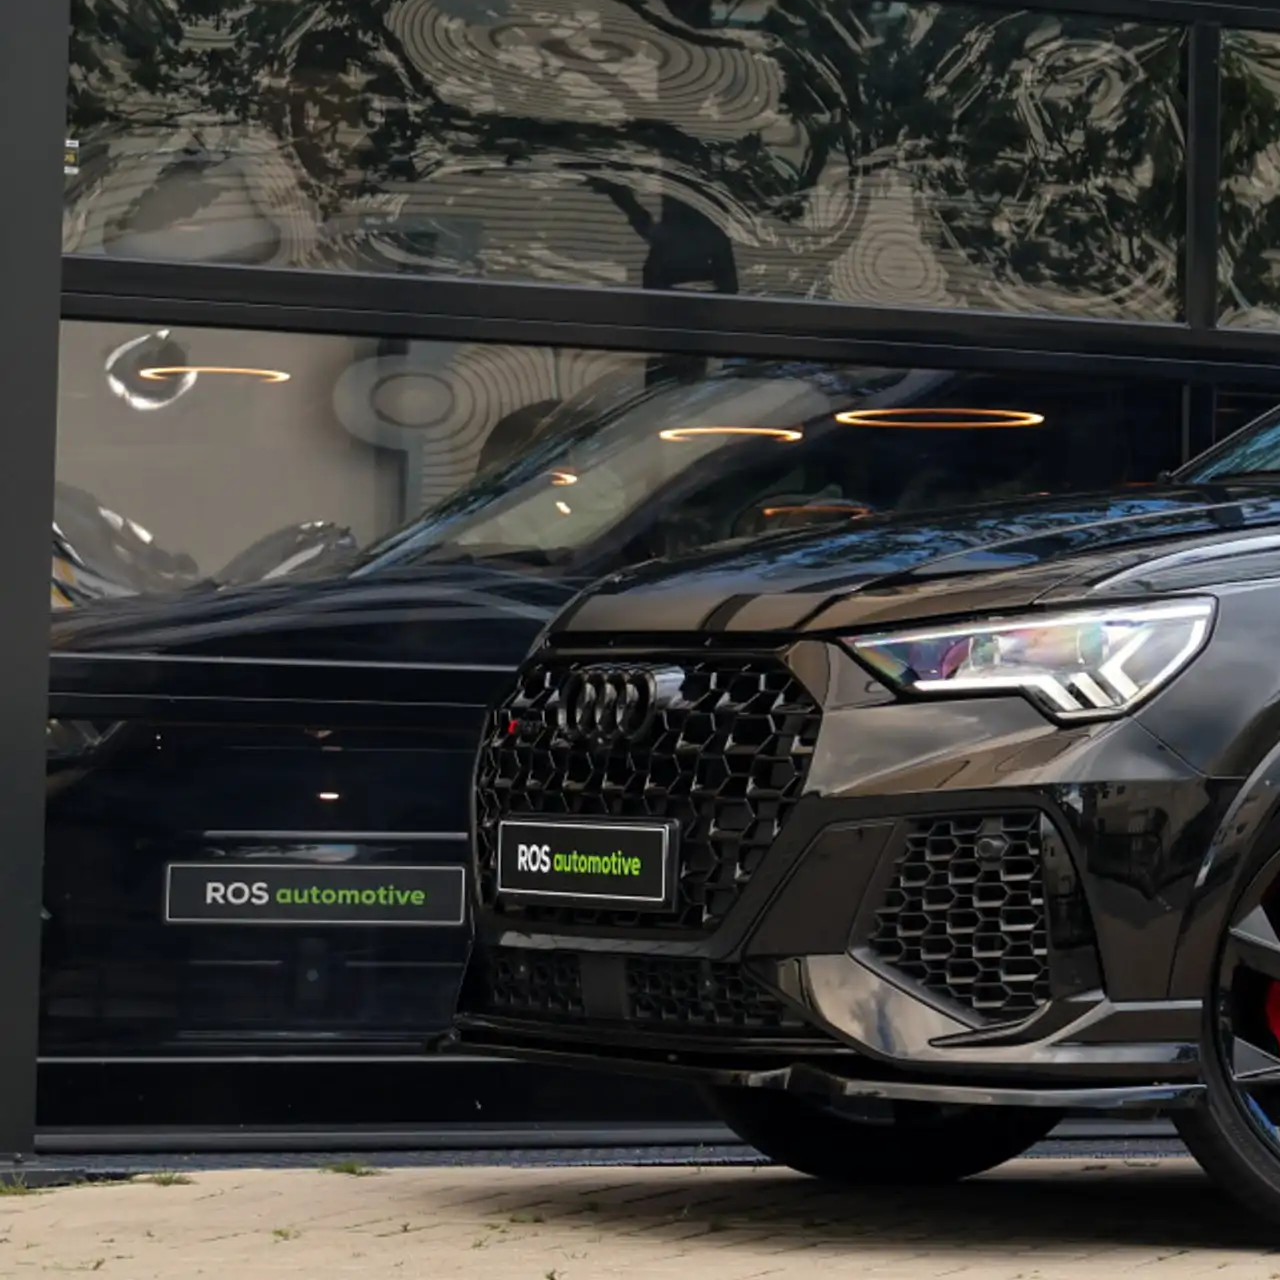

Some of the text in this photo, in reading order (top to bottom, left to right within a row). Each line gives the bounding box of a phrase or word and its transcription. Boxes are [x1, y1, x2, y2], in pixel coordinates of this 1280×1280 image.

[518, 843, 641, 876] ROS automotive
[205, 881, 426, 906] ROS automotive
